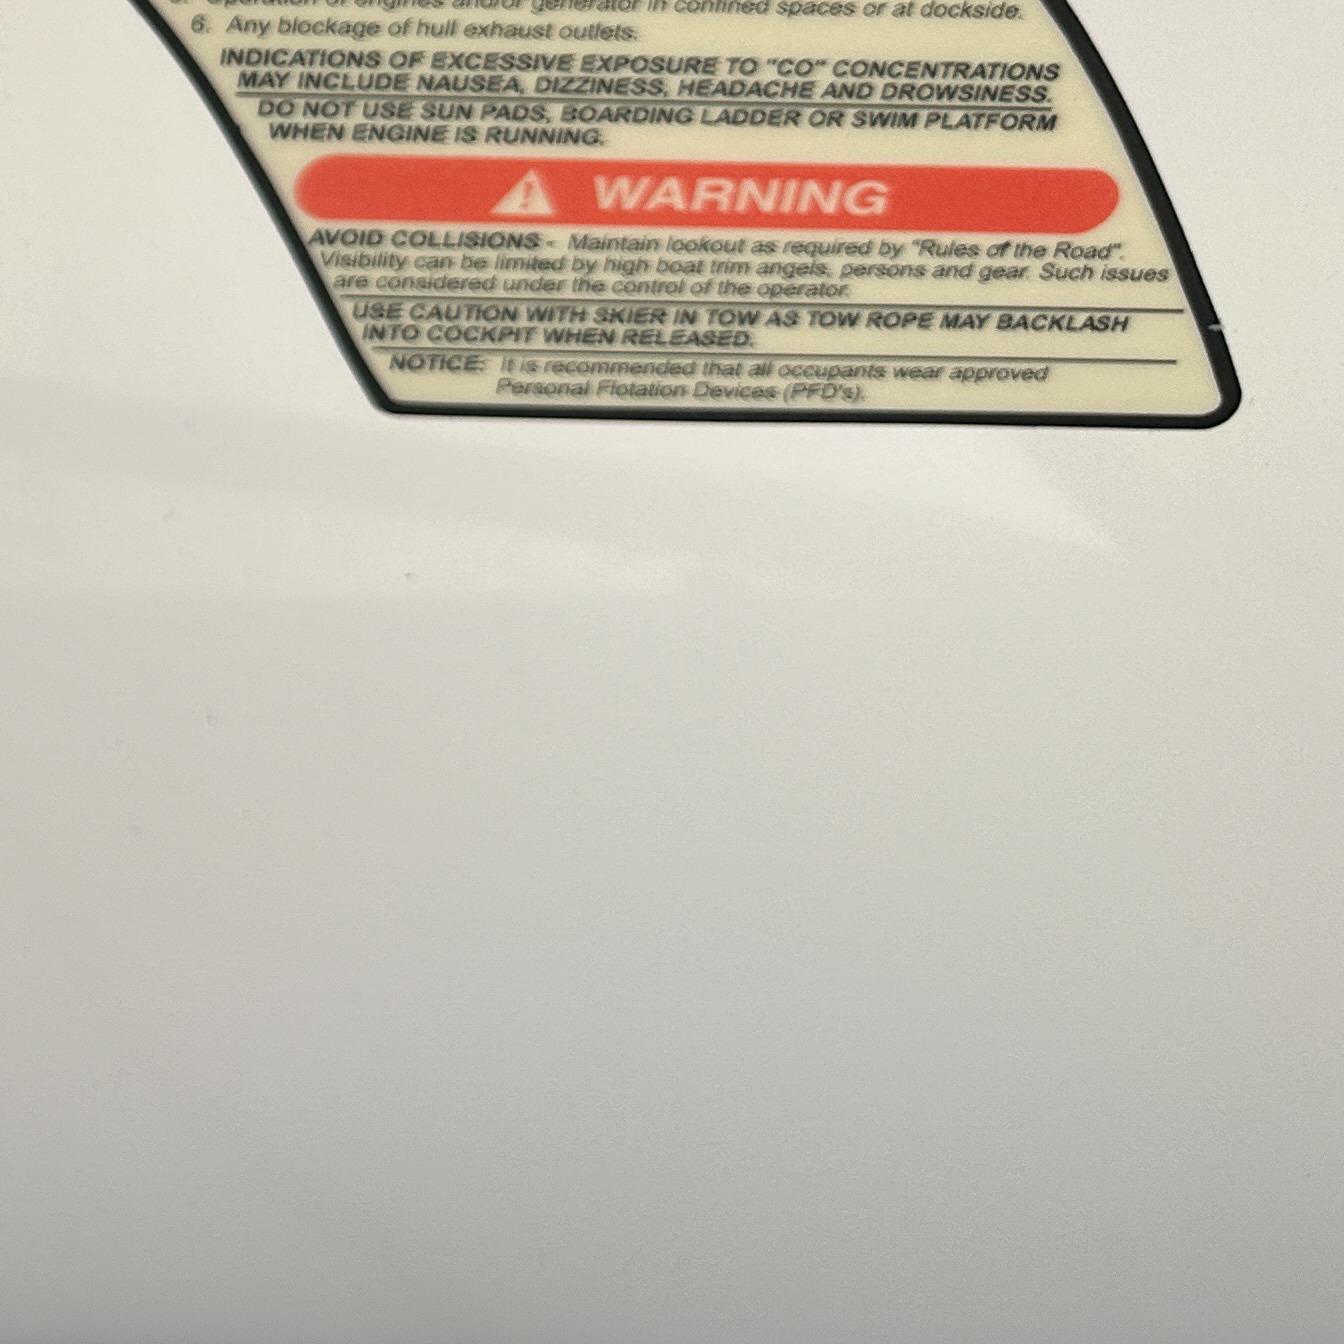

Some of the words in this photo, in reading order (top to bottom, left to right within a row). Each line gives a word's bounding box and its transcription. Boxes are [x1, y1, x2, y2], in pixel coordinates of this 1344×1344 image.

[593, 175, 890, 216] WARNING
[352, 302, 403, 322] USE
[408, 303, 519, 324] CAUTION
[526, 305, 587, 324] WITH
[593, 305, 667, 325] SKIER
[674, 306, 699, 326] IN
[705, 307, 762, 326] TOW
[766, 309, 802, 328] AS
[810, 309, 864, 329] TOW
[866, 311, 934, 331] ROPE
[939, 312, 991, 331] MAY
[996, 312, 1130, 333] BACKLASH
[362, 323, 419, 342] INTO
[426, 324, 536, 344] COCKPIT
[543, 326, 615, 346] WHEN
[622, 328, 755, 348] RELEASED.
